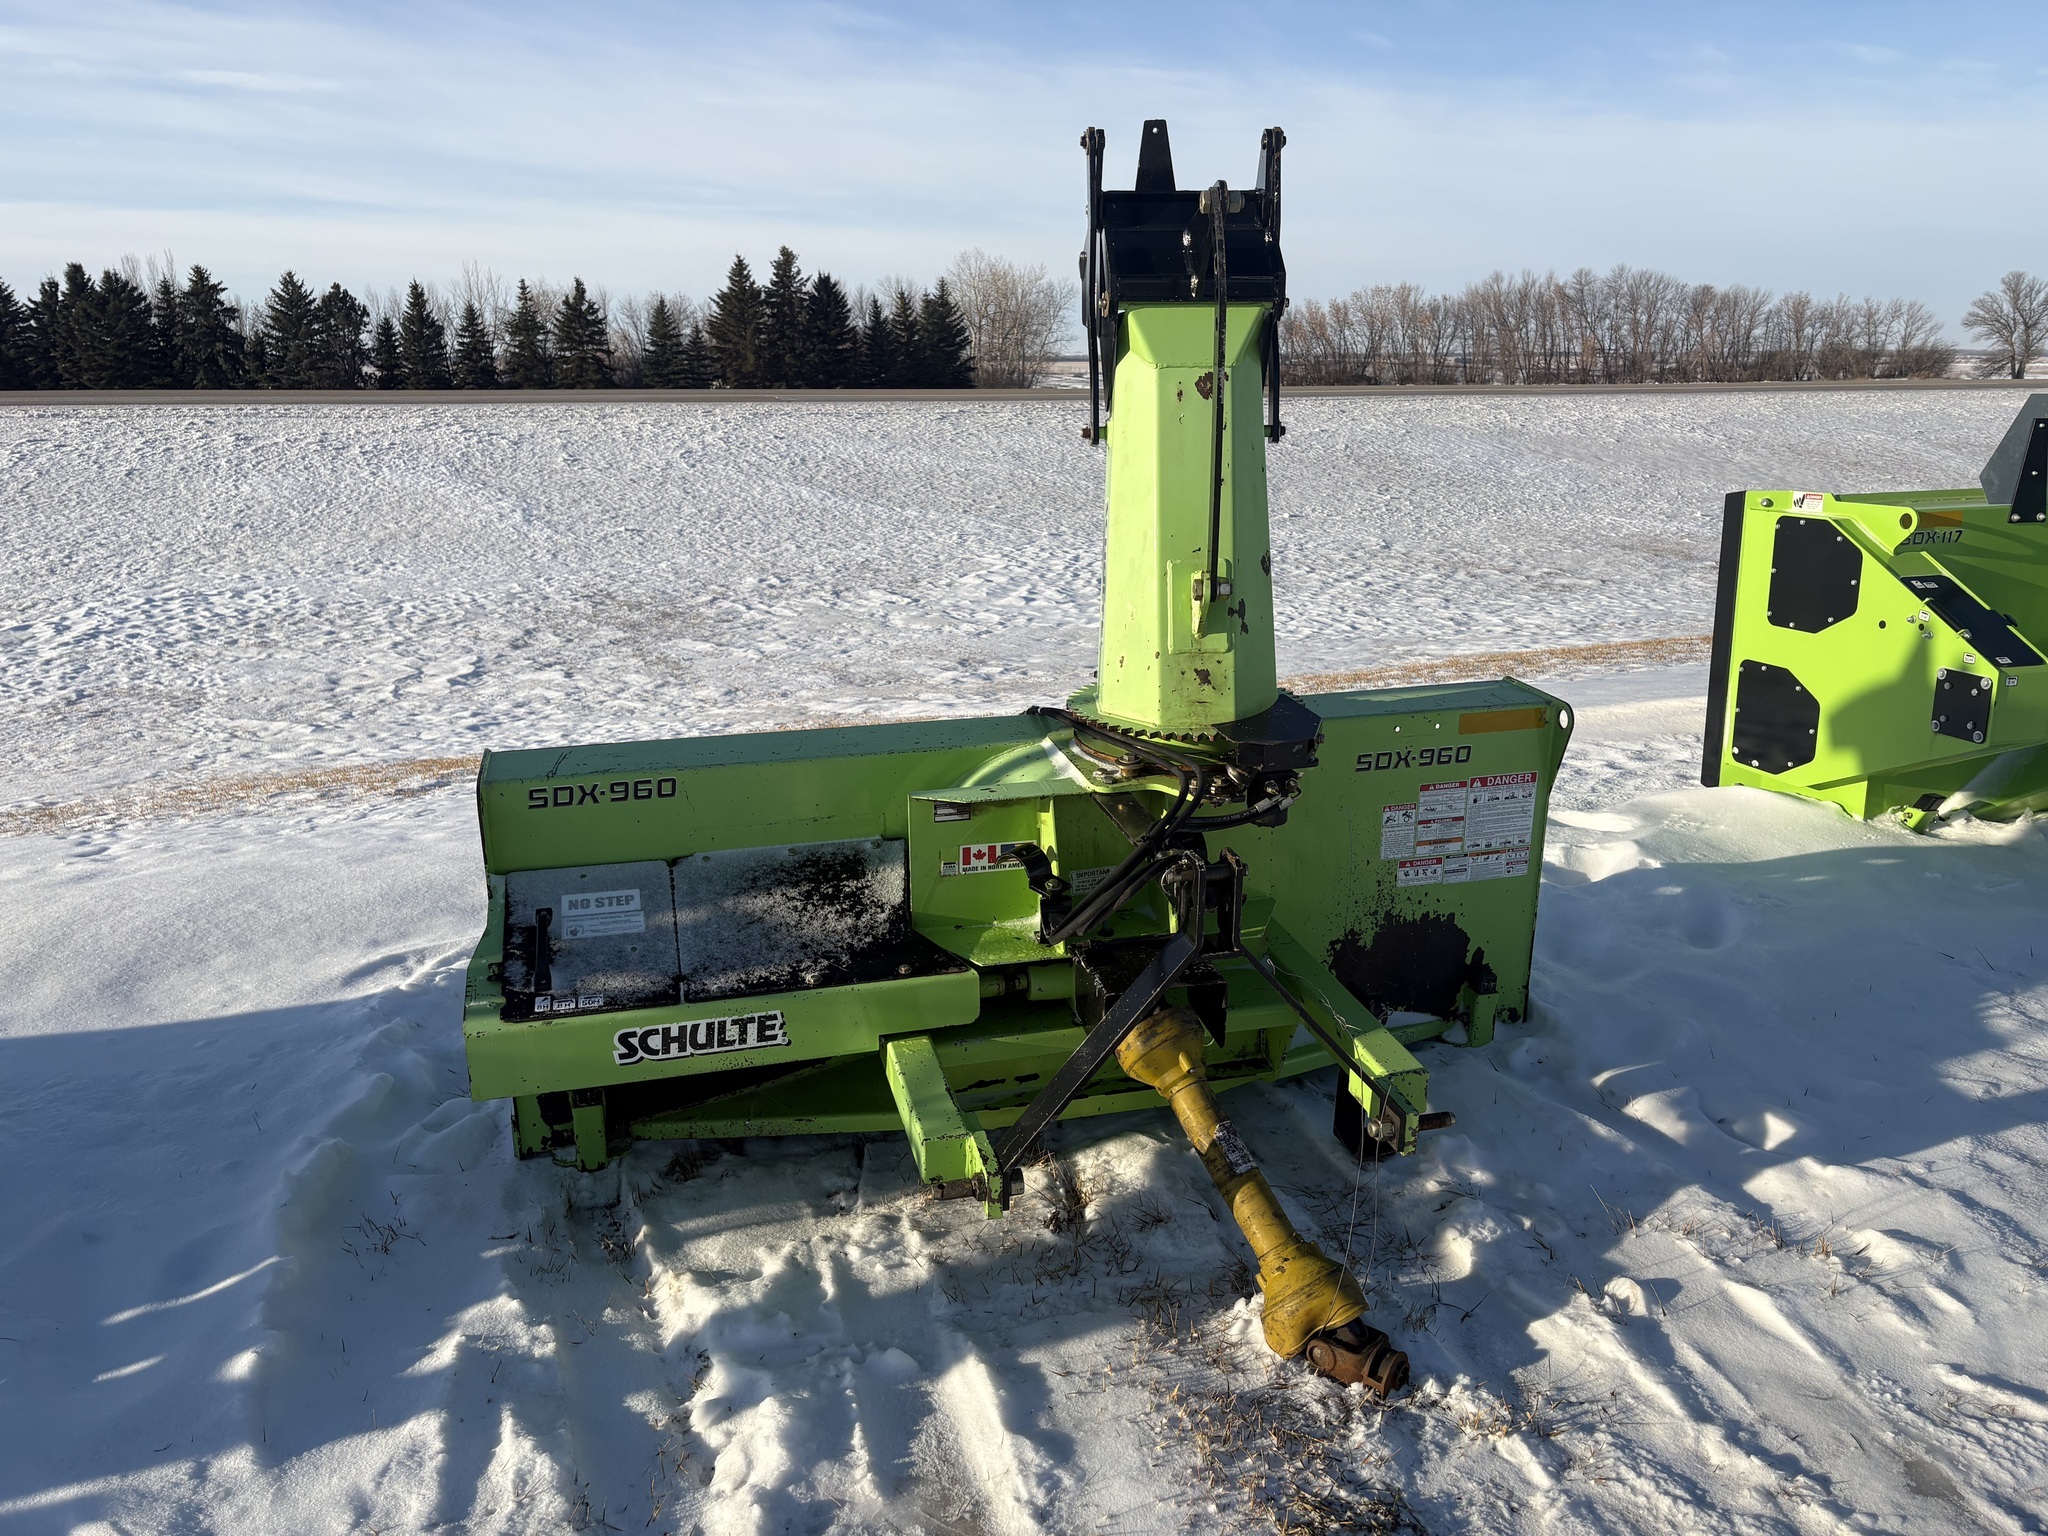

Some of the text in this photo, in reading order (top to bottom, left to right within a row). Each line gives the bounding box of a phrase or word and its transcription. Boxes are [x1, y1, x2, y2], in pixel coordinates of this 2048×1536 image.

[1487, 773, 1532, 786] DANGER
[1435, 782, 1460, 790] DANGER
[1390, 803, 1415, 811] DANGER
[1412, 858, 1437, 867] DANGER
[568, 895, 635, 911] NO STEP
[614, 1012, 782, 1062] SCHULTE
